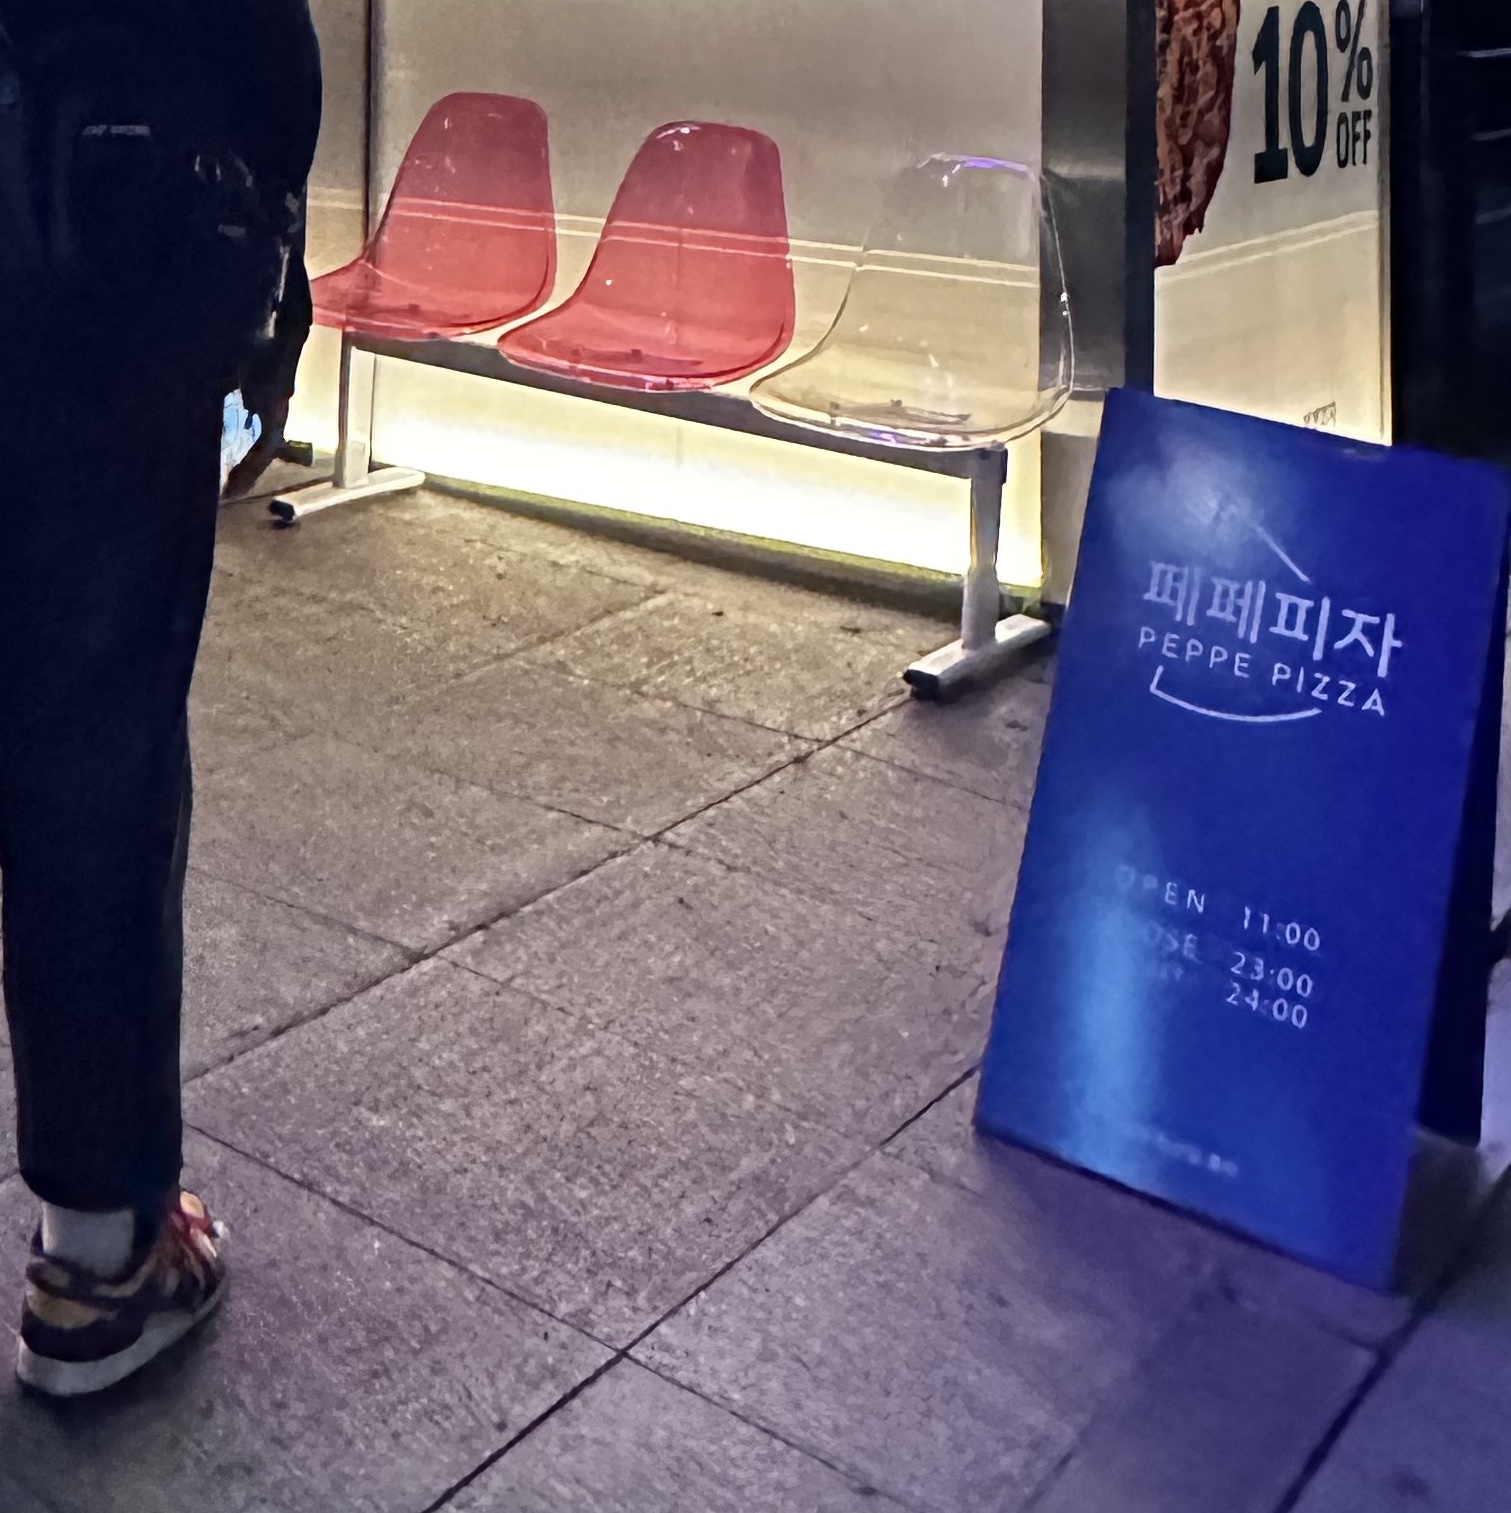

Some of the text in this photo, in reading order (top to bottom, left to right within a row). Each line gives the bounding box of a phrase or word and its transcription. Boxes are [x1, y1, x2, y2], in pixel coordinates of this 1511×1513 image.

[1336, 109, 1372, 168] OFF
[1143, 561, 1403, 677] 페페피자
[1138, 626, 1385, 717] PEPPE PIZZA
[1244, 906, 1320, 950] 11:00
[1231, 951, 1313, 998] 23:00
[1225, 980, 1307, 1028] 24:00
